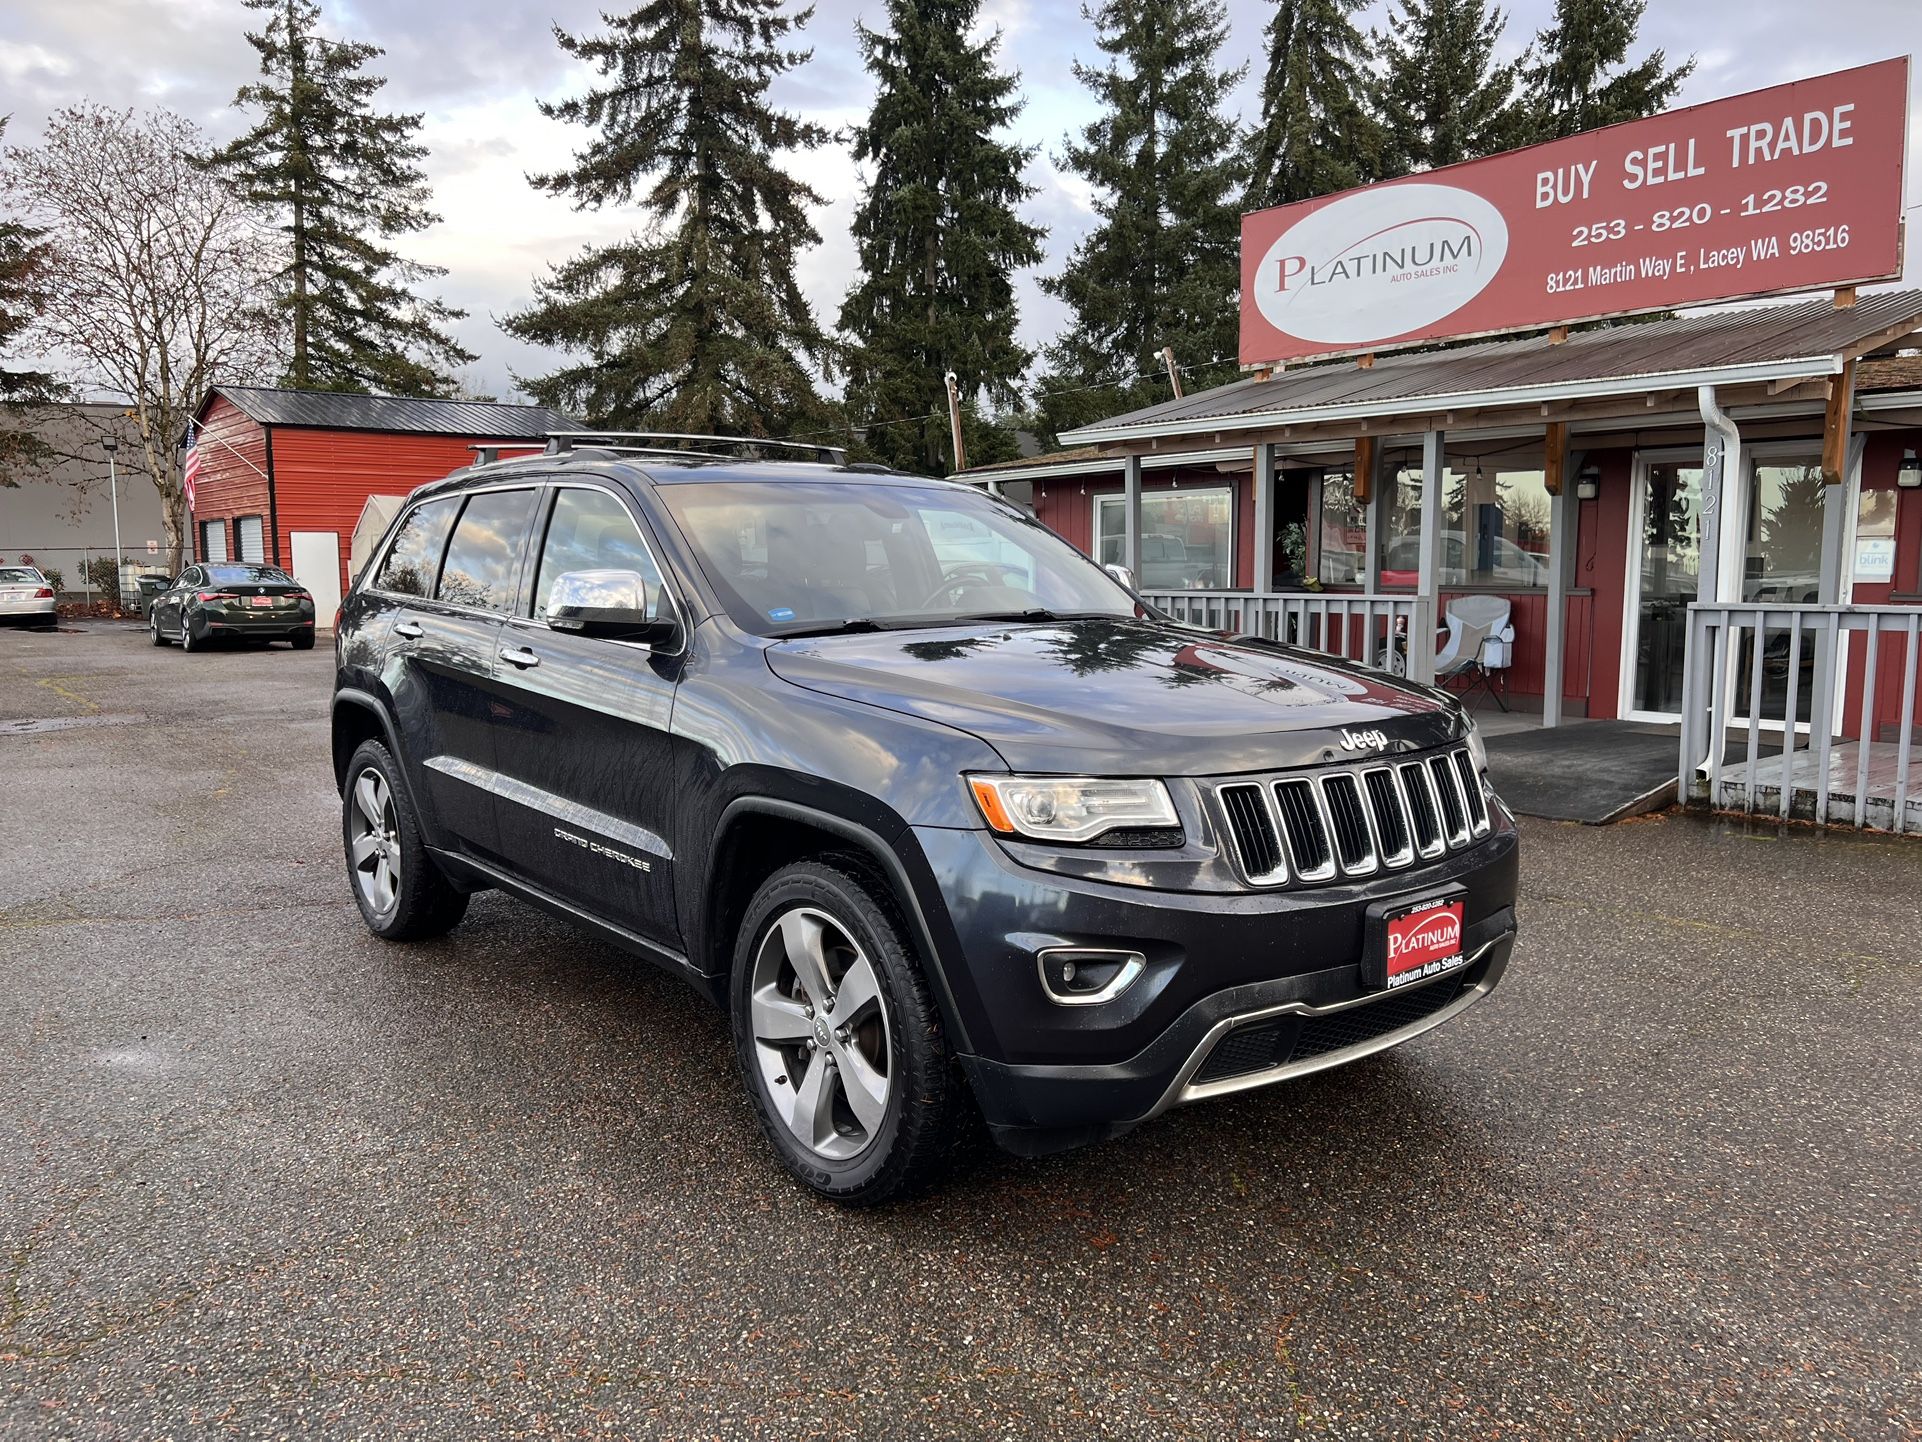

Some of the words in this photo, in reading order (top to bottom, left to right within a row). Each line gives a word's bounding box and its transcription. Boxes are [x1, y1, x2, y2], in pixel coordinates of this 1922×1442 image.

[1535, 160, 1597, 209] BUY
[1622, 138, 1705, 190] SELL
[1726, 103, 1855, 168] TRADE
[1571, 219, 1626, 247] 253
[1651, 203, 1712, 233] 820
[1740, 181, 1829, 217] 1282
[1274, 235, 1472, 294] PLATINUM
[1390, 268, 1412, 284] AUTO
[1413, 265, 1441, 280] SALES
[1443, 263, 1459, 275] INC
[1546, 267, 1585, 294] 8121
[1588, 261, 1635, 287] Martin
[1640, 256, 1672, 280] Way
[1699, 244, 1747, 269] Lacey
[1751, 236, 1780, 261] WA
[1789, 224, 1849, 255] 98516
[1702, 446, 1718, 541] 8121
[1859, 554, 1889, 565] blink
[1340, 728, 1388, 751] Jeep
[1388, 924, 1459, 958] PLATINUM
[1387, 968, 1422, 989] Platinum
[1423, 962, 1441, 977] Auto
[1441, 954, 1464, 969] Sales
